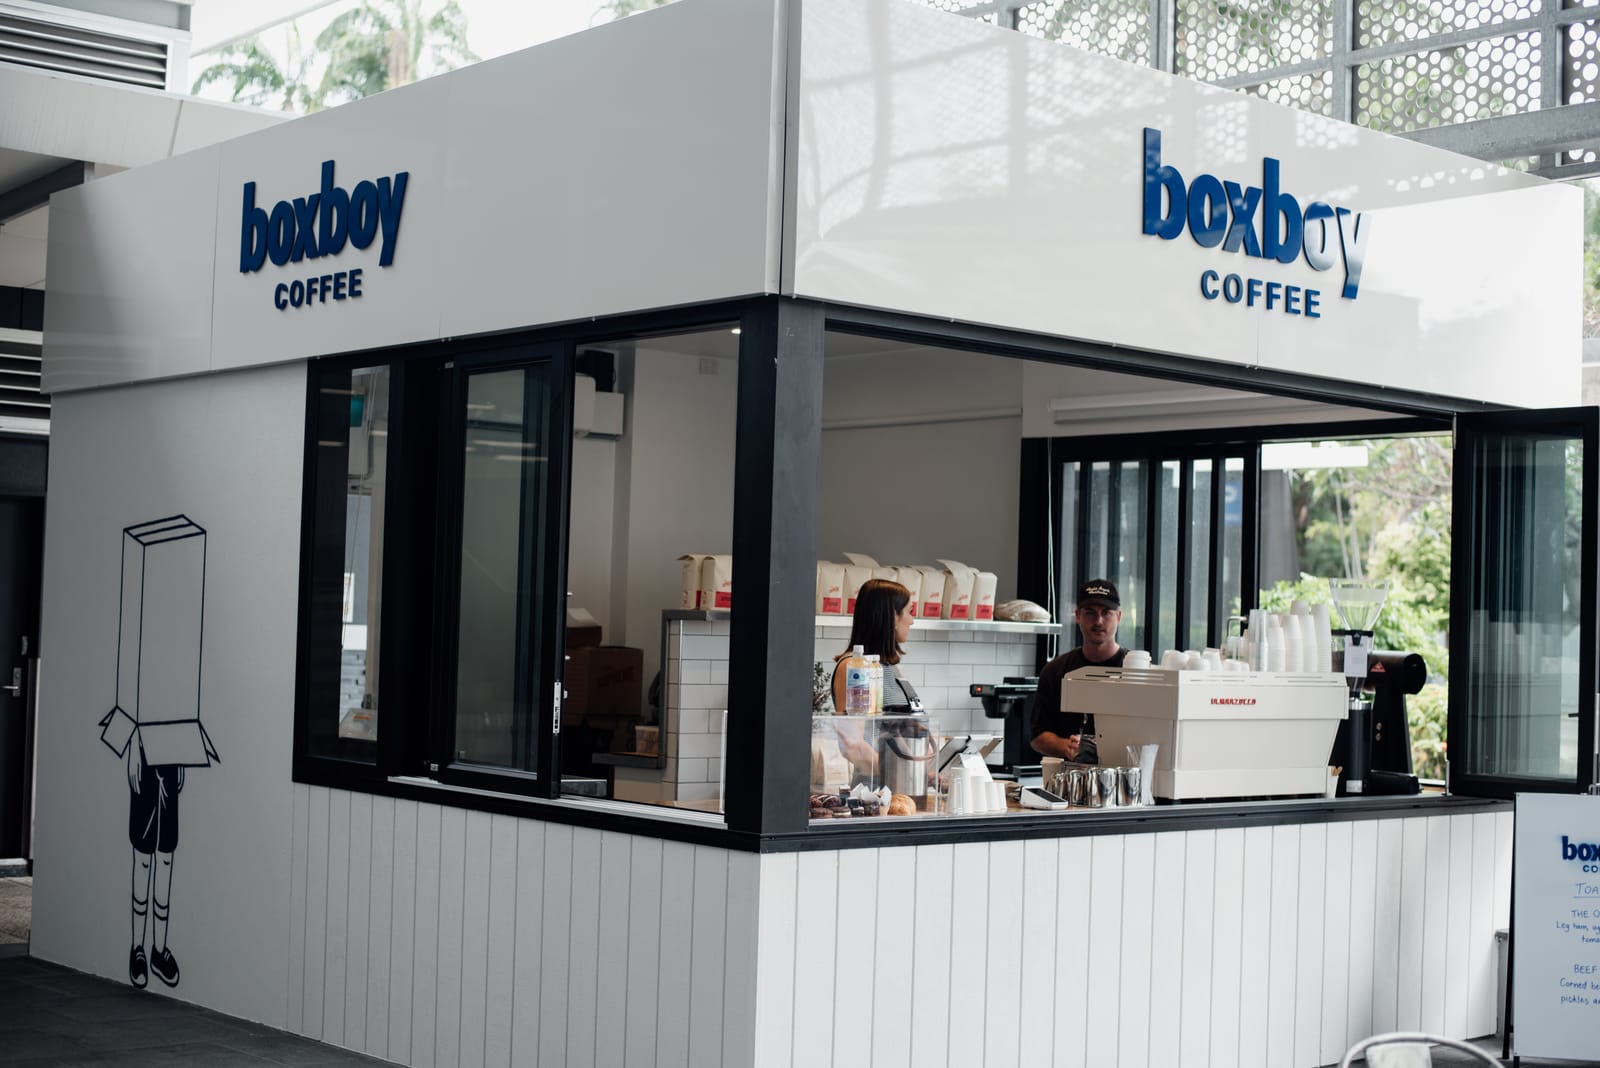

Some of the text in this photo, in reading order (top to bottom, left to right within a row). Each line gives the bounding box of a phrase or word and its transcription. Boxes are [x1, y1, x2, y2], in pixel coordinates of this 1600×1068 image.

[240, 160, 409, 274] boxboy
[1142, 127, 1372, 299] boxboy
[274, 268, 363, 310] COFFEE
[1201, 269, 1321, 318] COFFEE
[1571, 909, 1589, 918] THE
[1560, 977, 1587, 989] Corned
[1574, 963, 1598, 974] BEEF
